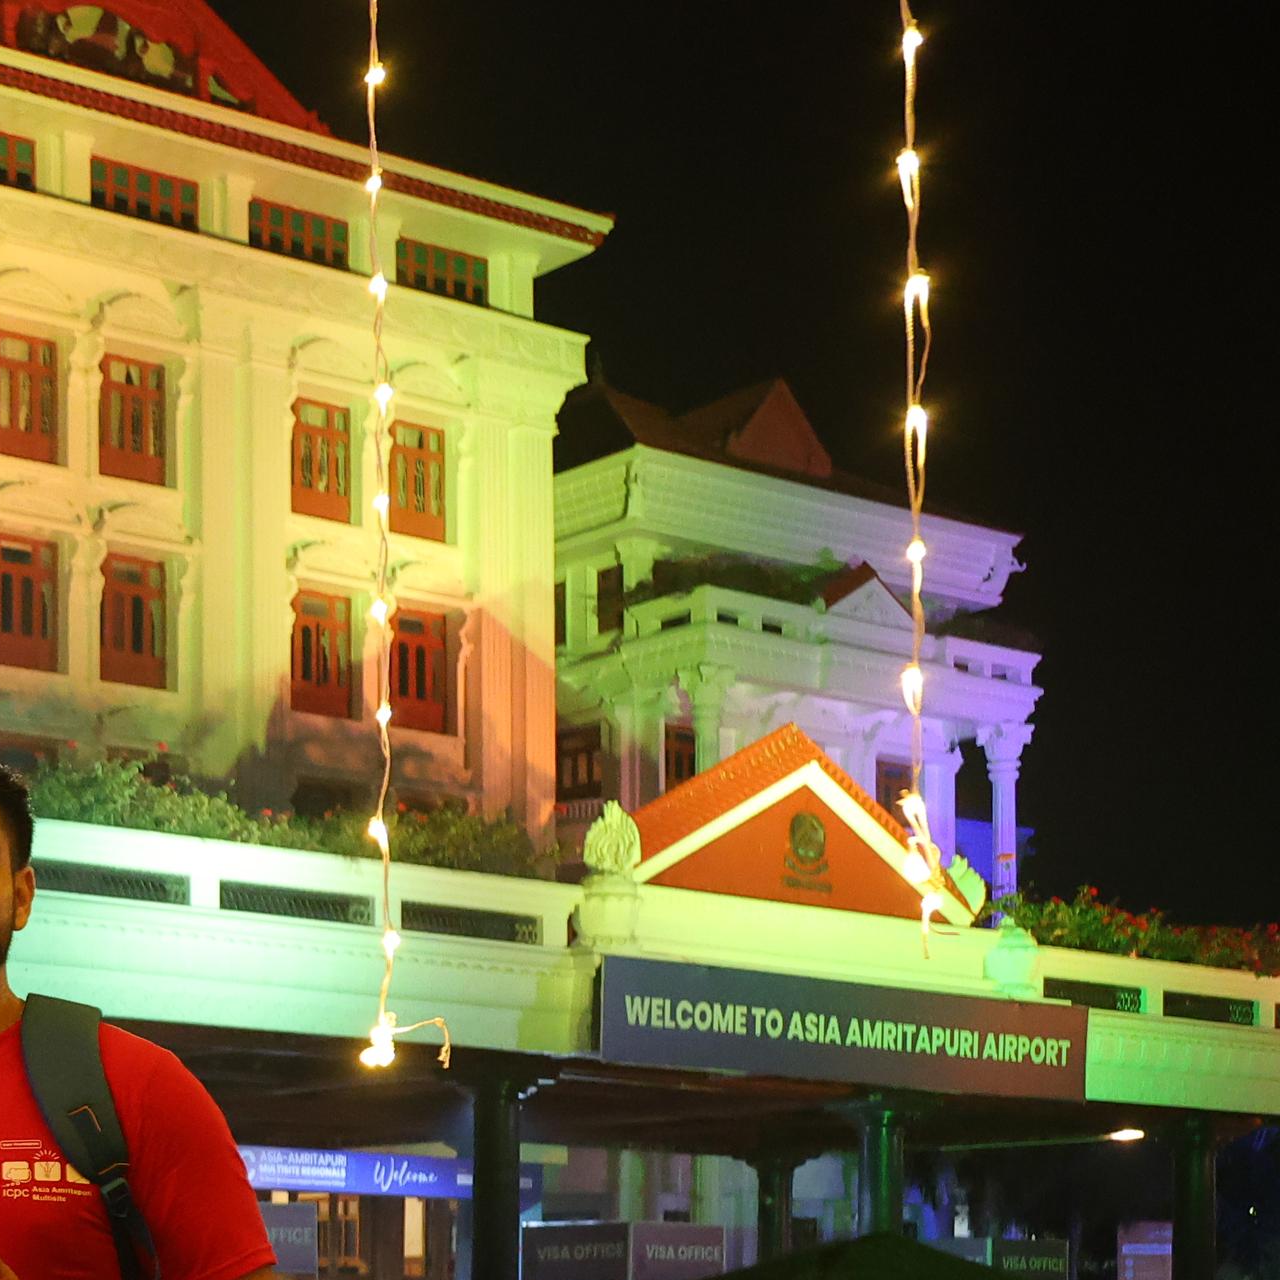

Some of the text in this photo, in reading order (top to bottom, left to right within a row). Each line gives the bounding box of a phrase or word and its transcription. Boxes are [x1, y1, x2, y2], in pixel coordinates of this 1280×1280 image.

[624, 995, 1071, 1067] WELCOME TO ASIA AMRITAPURI AIRPORT
[260, 1151, 347, 1167] ASIA-AMRITAPURI
[301, 1166, 346, 1178] REGIONALS
[373, 1156, 438, 1192] Welcome
[2, 1188, 30, 1199] icpc
[270, 1226, 314, 1246] FFICE
[538, 1245, 570, 1261] VISA
[646, 1244, 722, 1262] VISA OFFICE
[1002, 1256, 1065, 1272] VISA OFFICE
